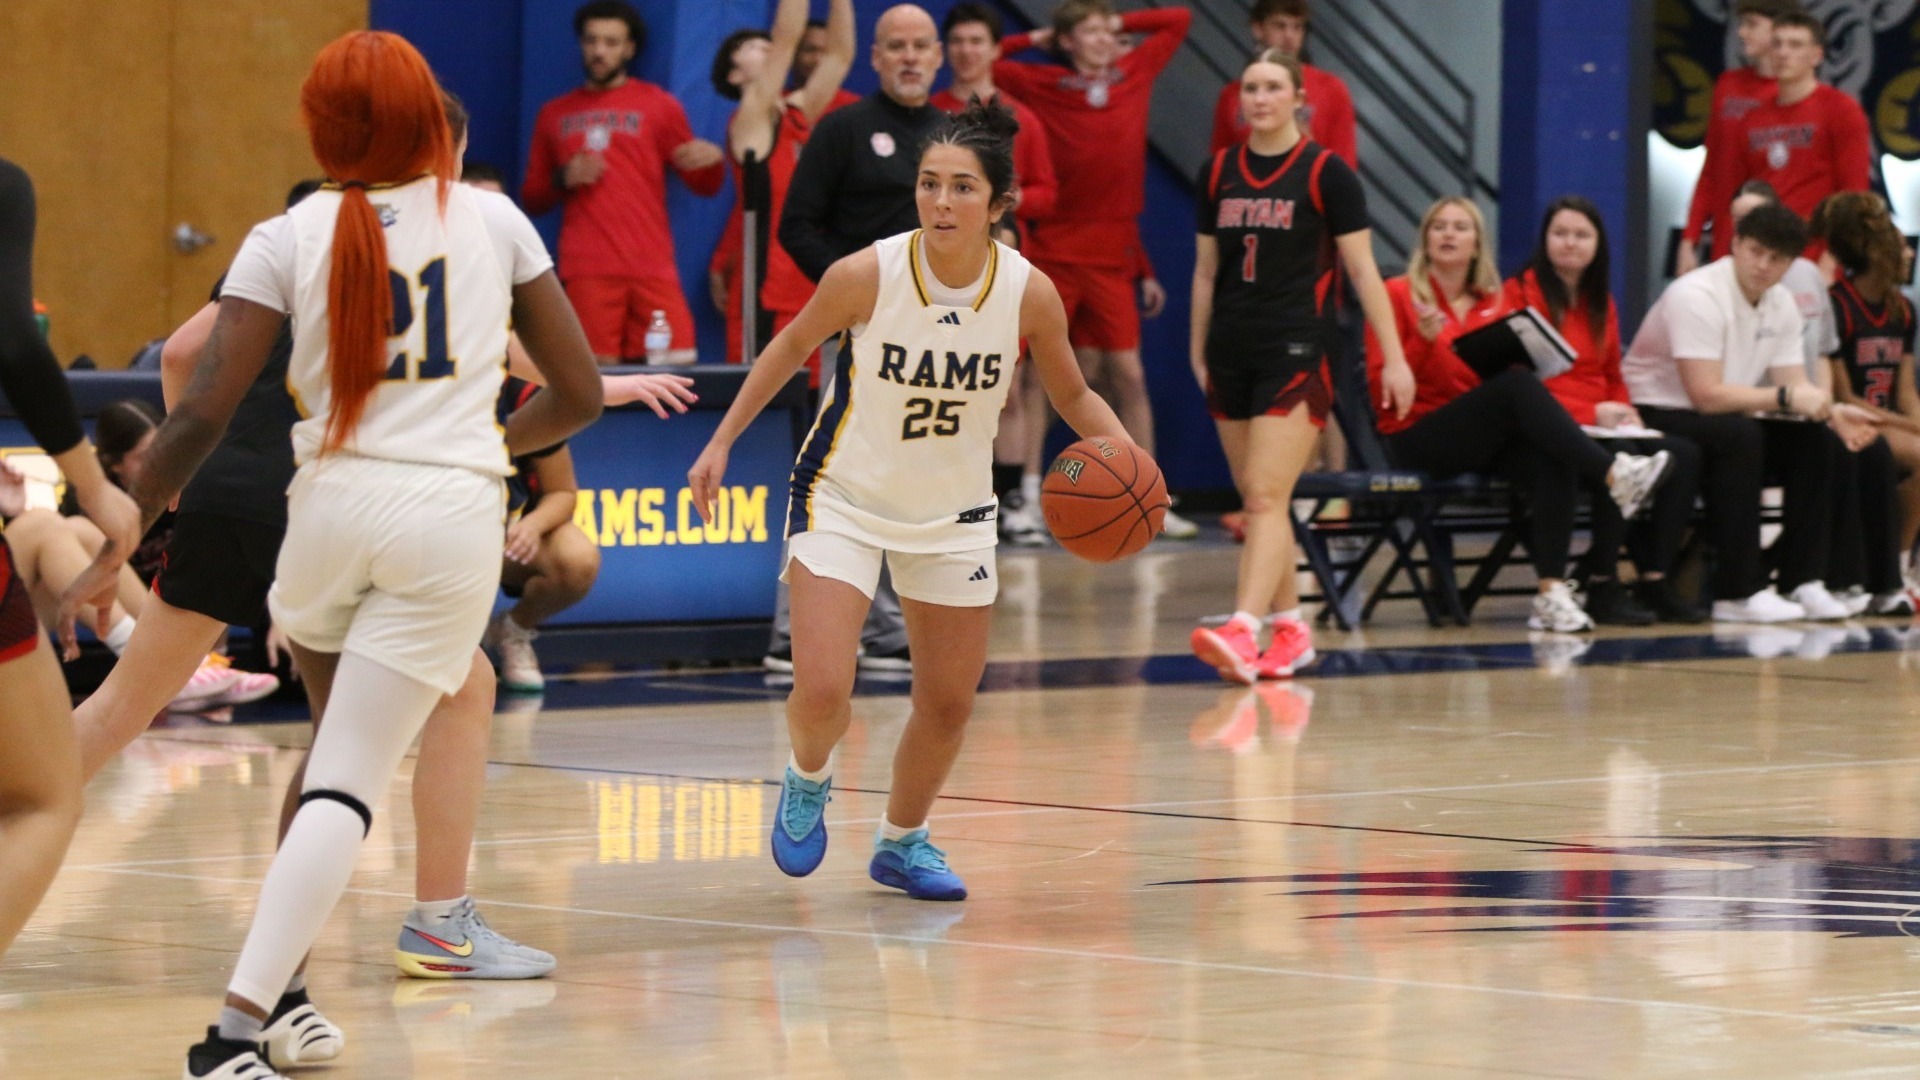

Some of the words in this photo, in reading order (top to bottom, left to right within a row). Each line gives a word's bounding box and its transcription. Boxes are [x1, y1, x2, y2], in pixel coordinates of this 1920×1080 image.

[1217, 198, 1295, 230] BRYAN
[1242, 234, 1258, 282] 1
[878, 342, 1002, 391] RAMS
[901, 397, 968, 440] 25
